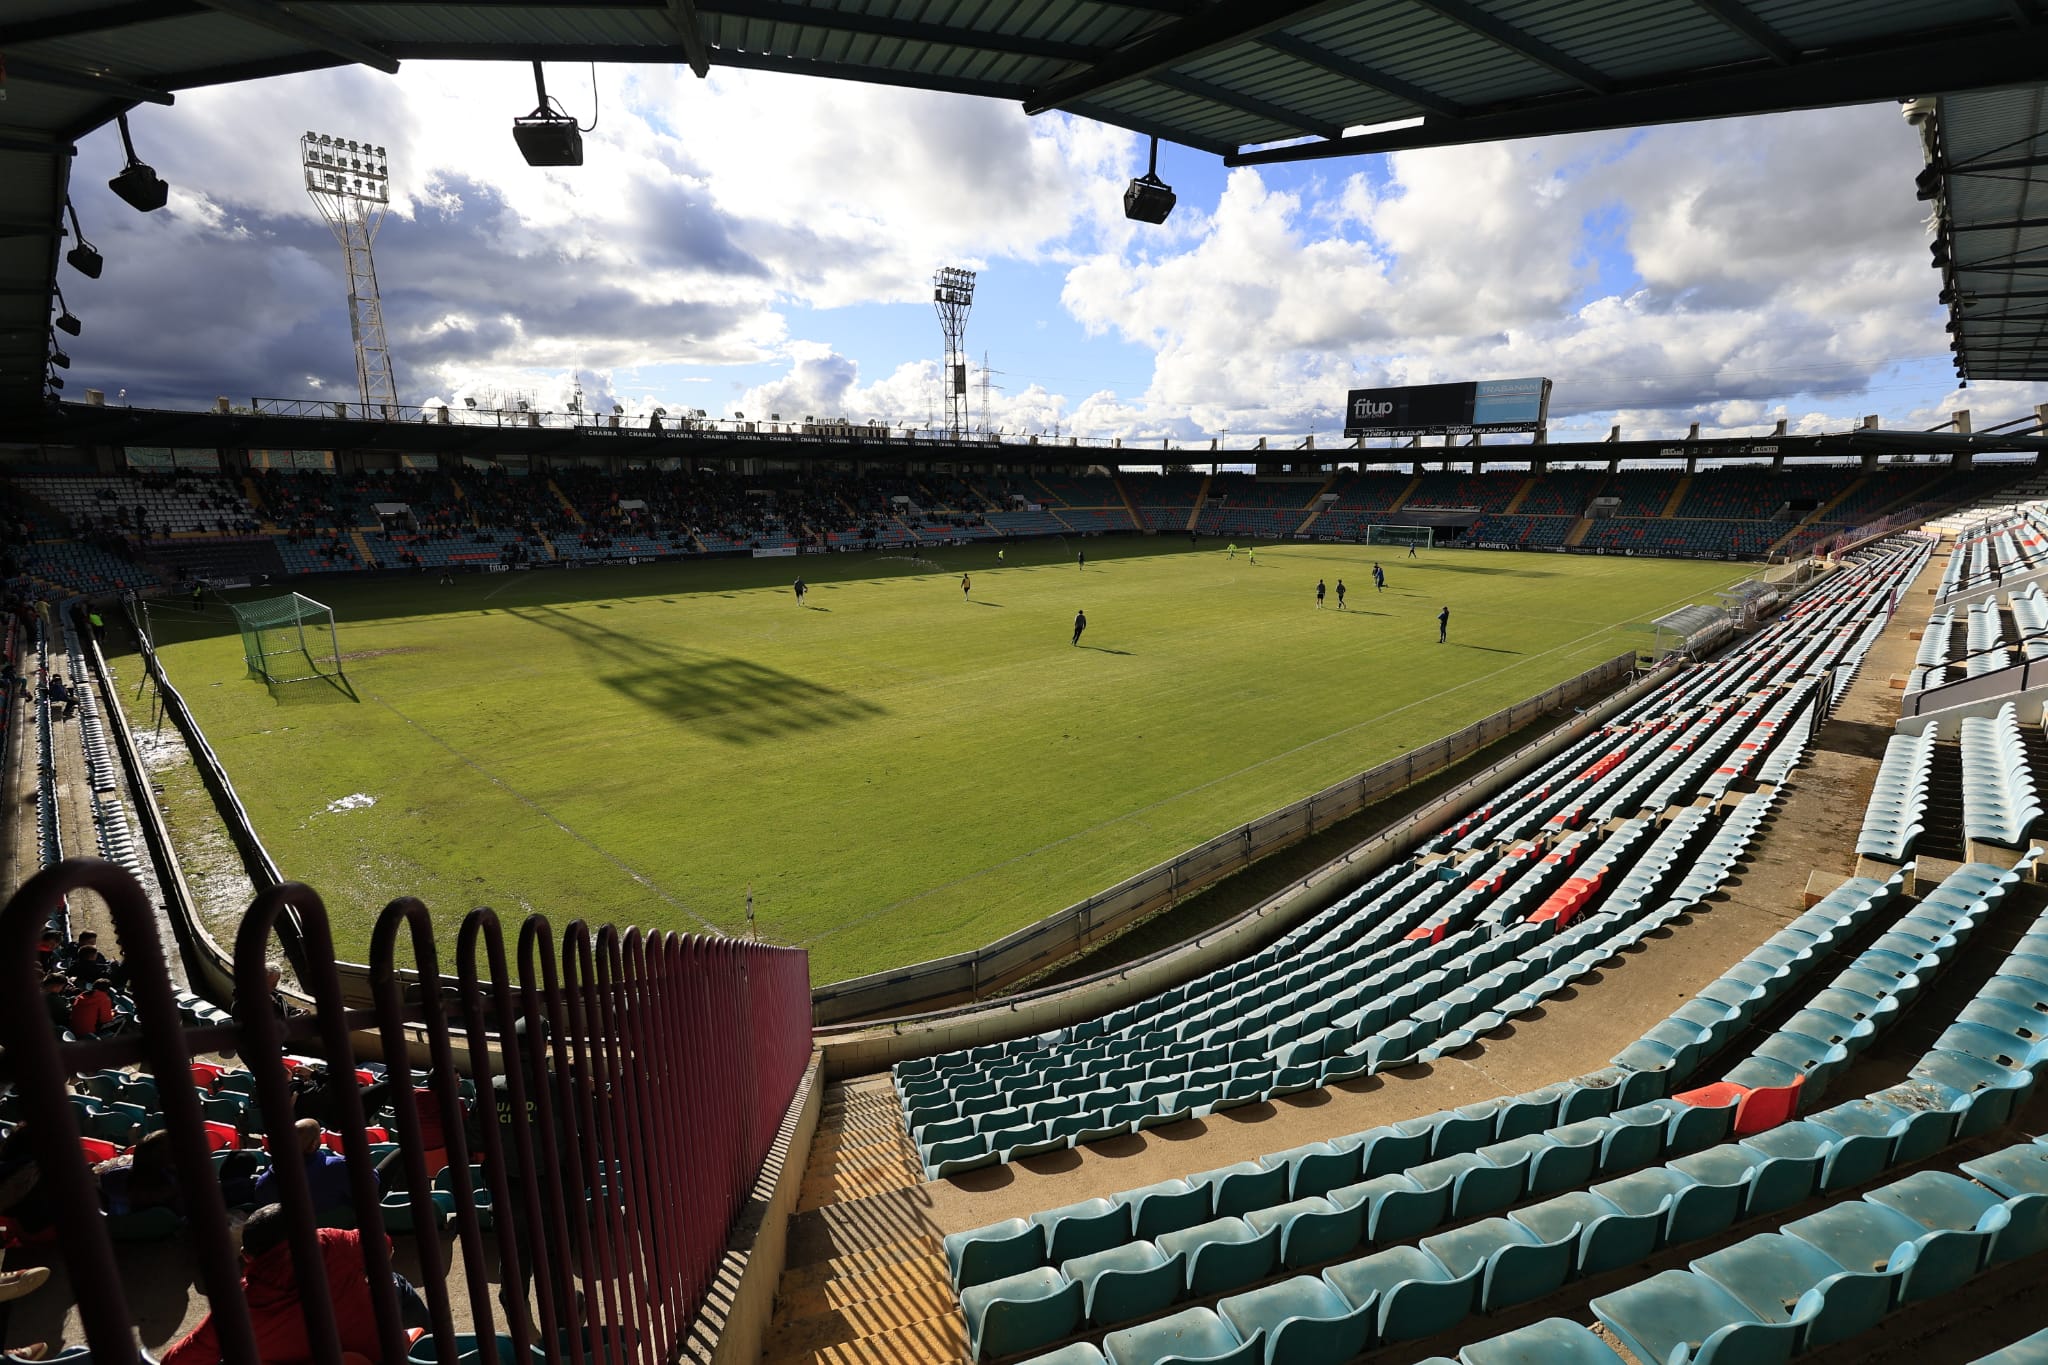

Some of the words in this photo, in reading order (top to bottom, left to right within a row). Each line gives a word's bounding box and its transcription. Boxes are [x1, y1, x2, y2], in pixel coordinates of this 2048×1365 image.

[1354, 398, 1393, 417] fitup
[588, 430, 618, 438] CHARRA
[666, 432, 693, 440] CHARRA
[489, 563, 510, 572] fitup
[499, 1113, 534, 1124] CIL
